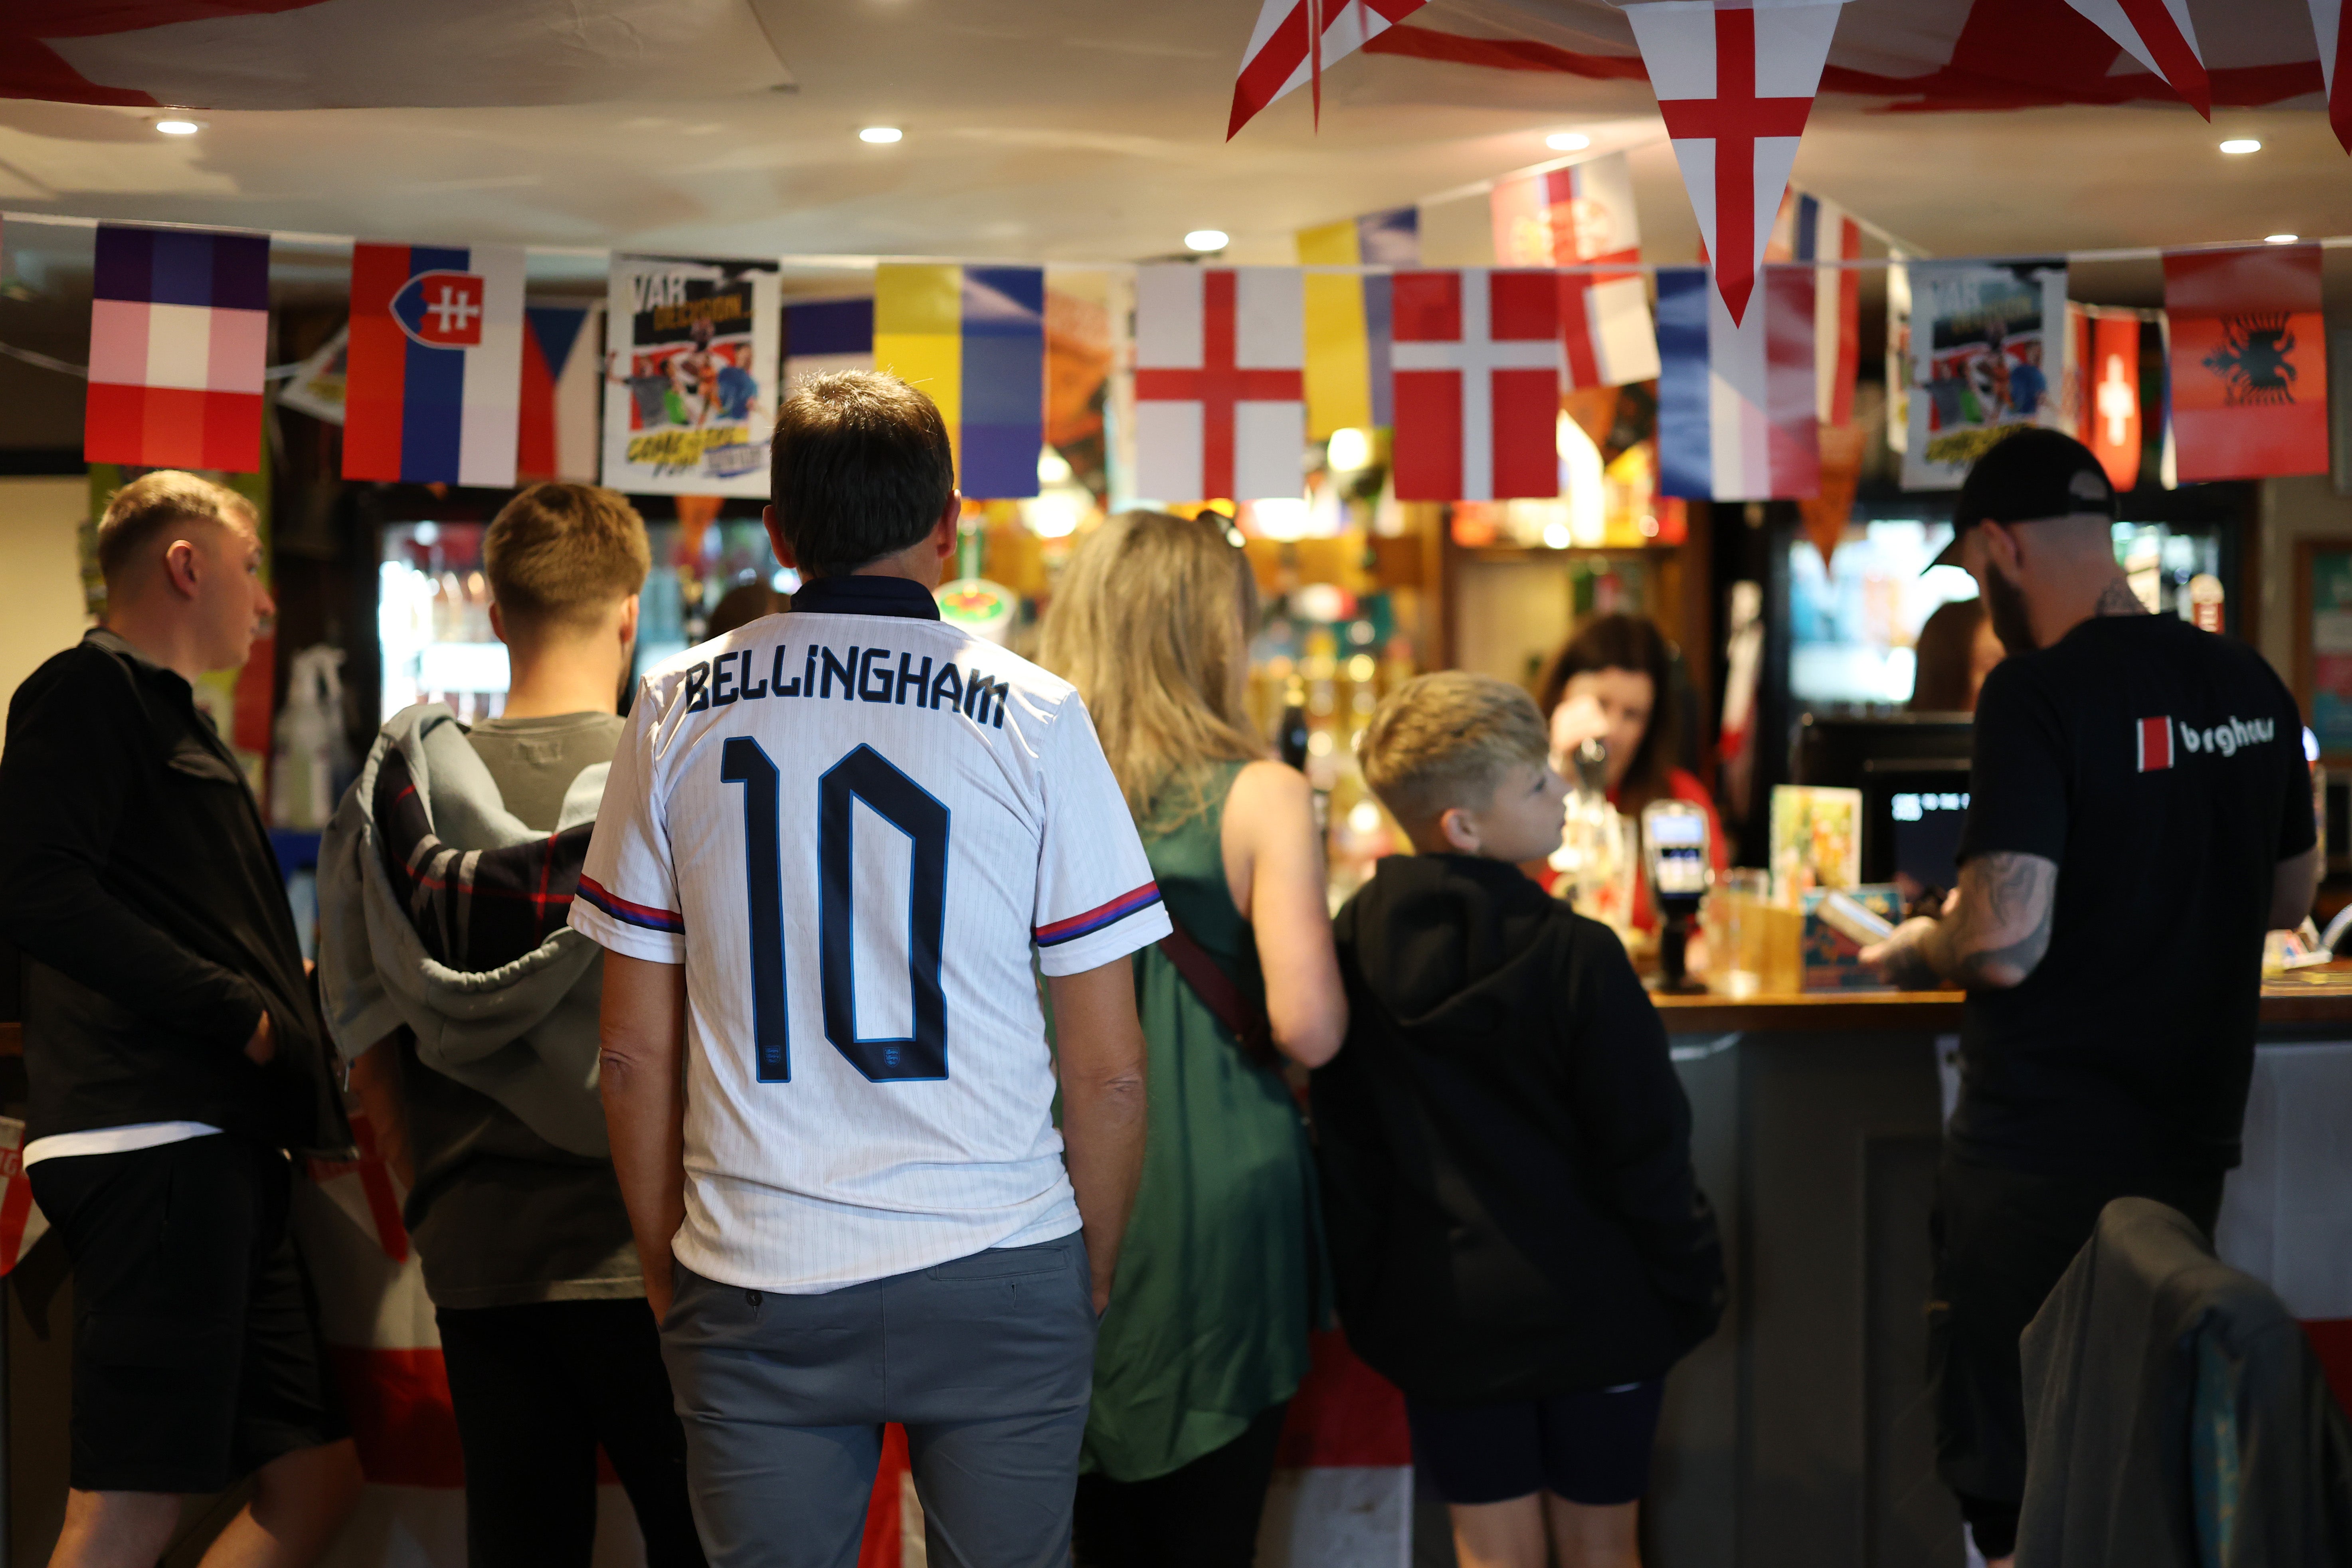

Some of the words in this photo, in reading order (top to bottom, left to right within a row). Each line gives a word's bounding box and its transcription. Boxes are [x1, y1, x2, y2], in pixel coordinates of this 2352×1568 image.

[631, 274, 686, 312] VAR
[685, 644, 1010, 729] BELLINGHAM
[720, 736, 951, 1083] 10
